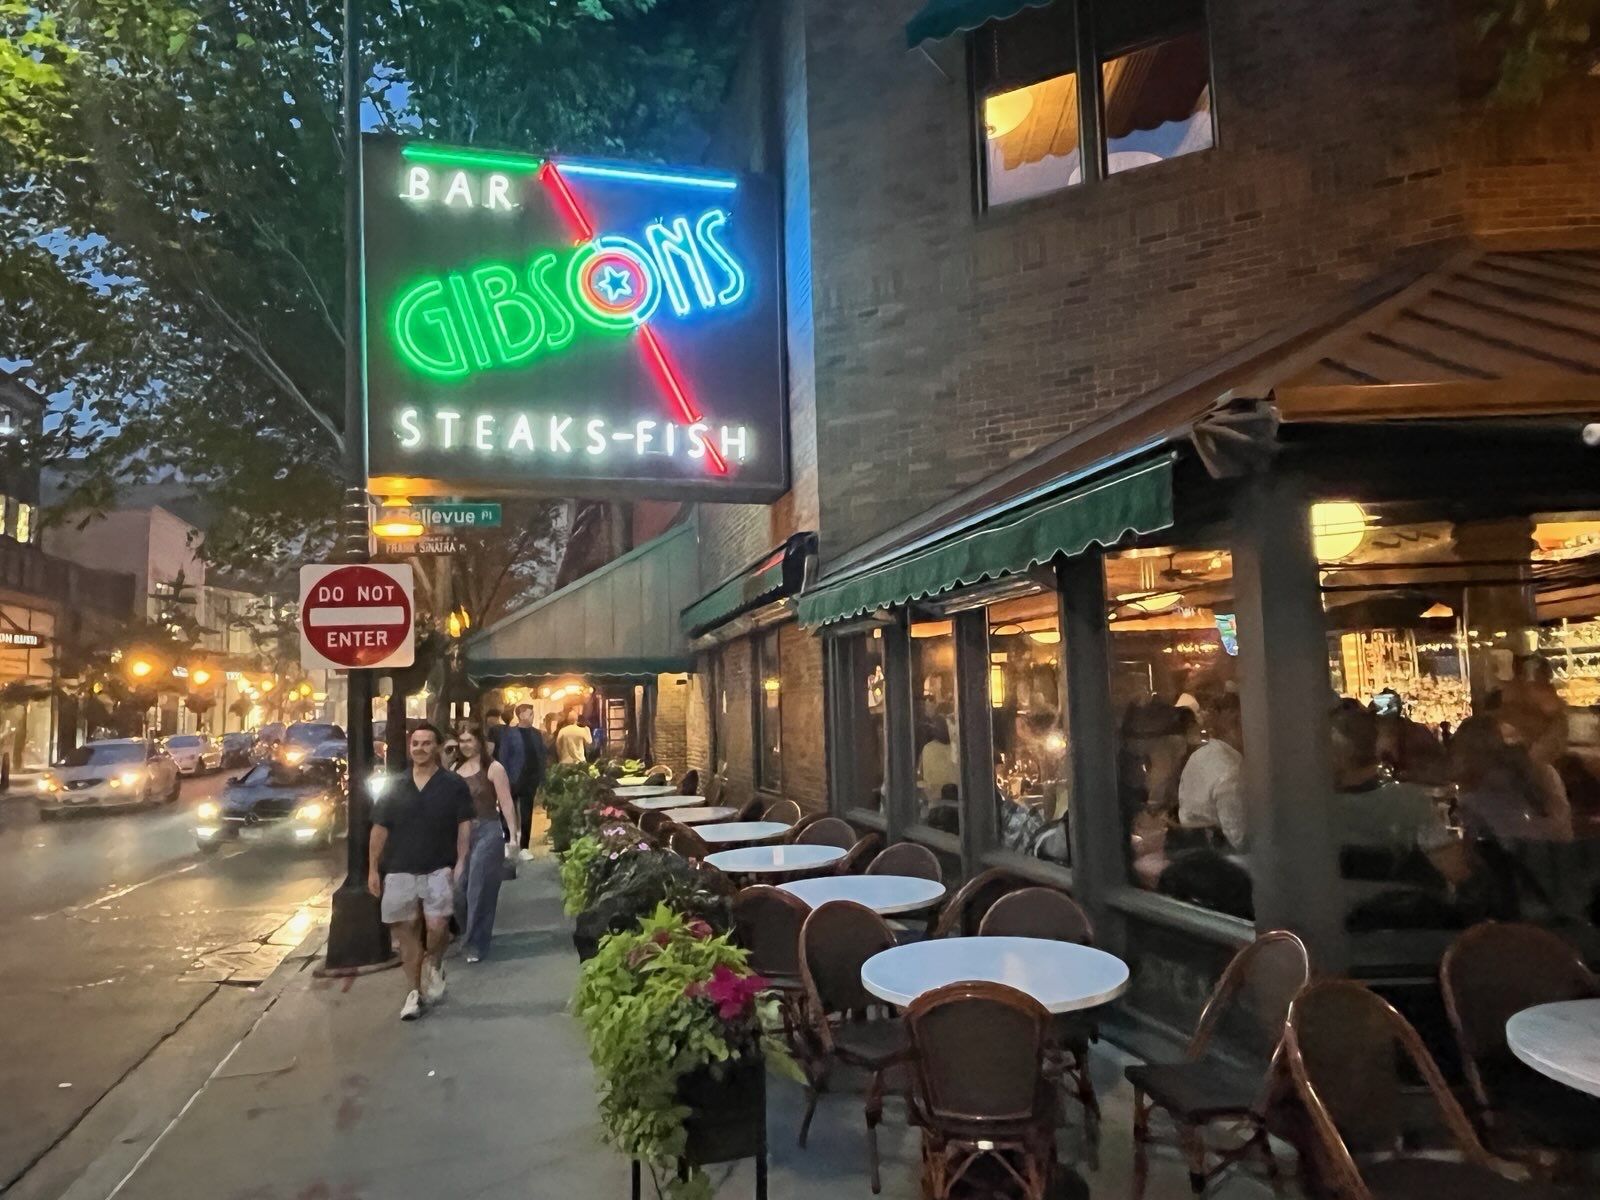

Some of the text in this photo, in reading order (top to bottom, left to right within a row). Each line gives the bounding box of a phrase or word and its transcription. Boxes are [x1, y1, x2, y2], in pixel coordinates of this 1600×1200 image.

[405, 166, 513, 210] BAR
[395, 209, 745, 376] GIBSONS
[398, 409, 747, 461] STEAKS-FISH
[318, 585, 394, 603] DO NOT
[326, 630, 388, 648] ENTER
